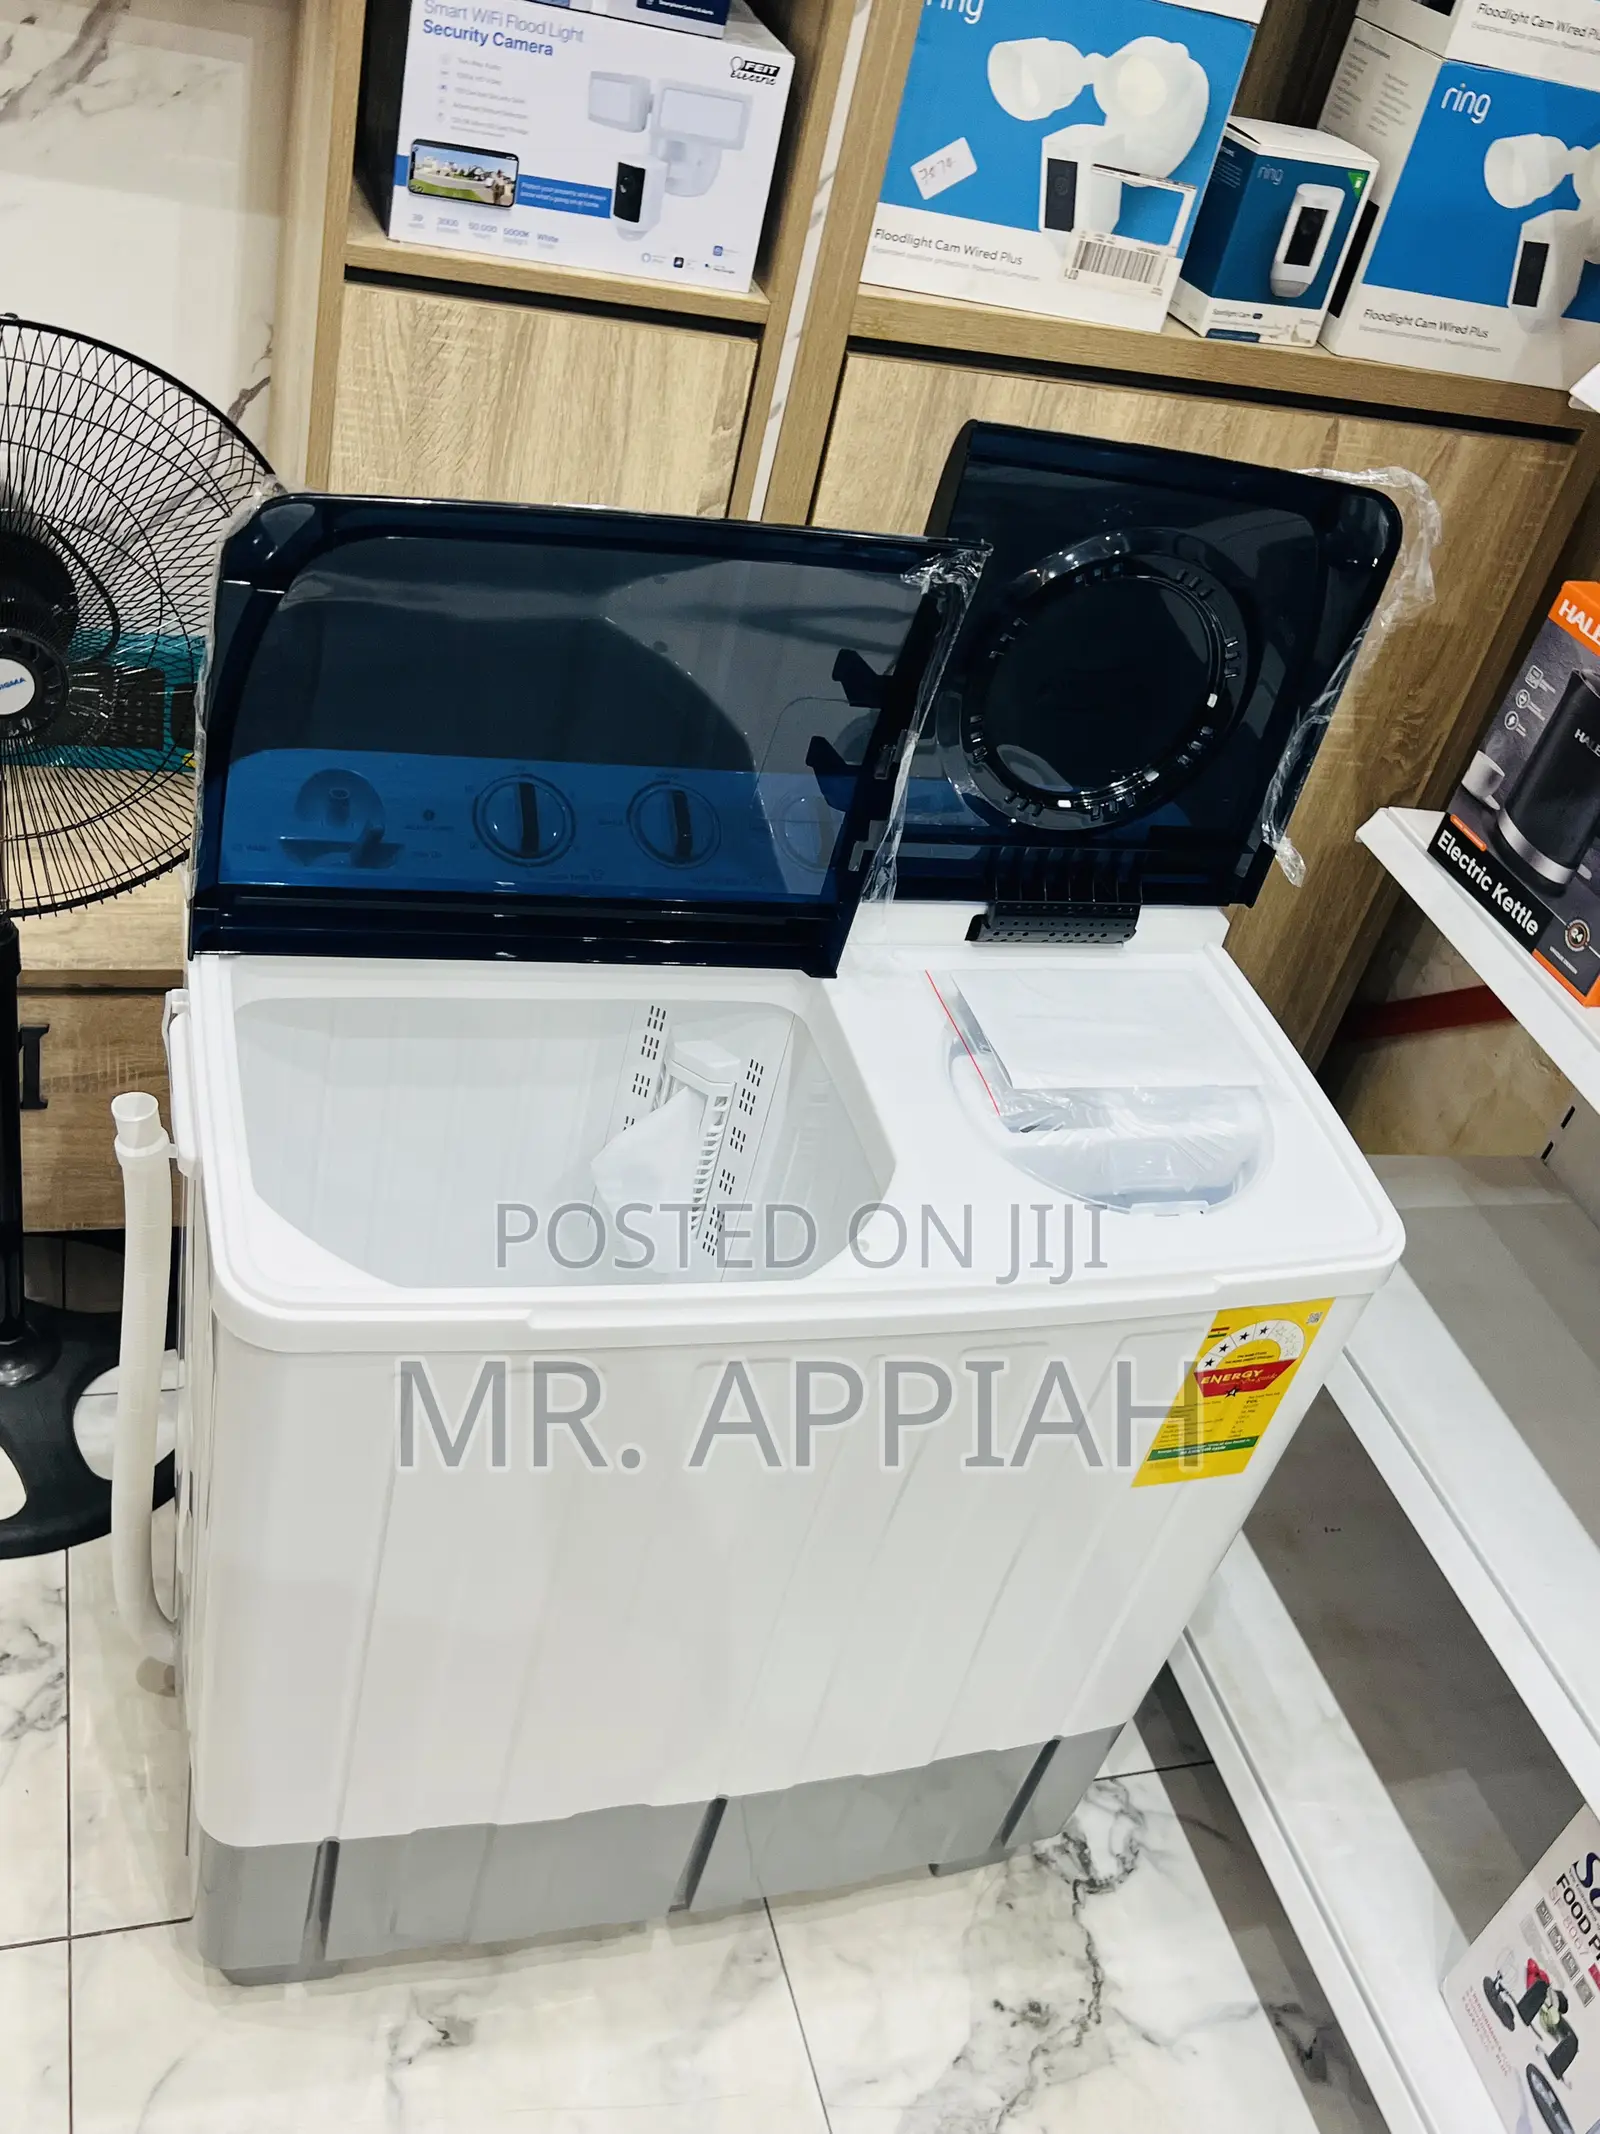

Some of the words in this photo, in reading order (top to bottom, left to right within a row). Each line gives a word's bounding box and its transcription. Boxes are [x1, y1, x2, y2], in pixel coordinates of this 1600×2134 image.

[424, 0, 467, 21] Smart
[506, 13, 546, 34] Flood
[549, 22, 584, 43] Light
[926, 0, 984, 24] ng
[1477, 2, 1530, 24] Floodlight
[1531, 15, 1554, 29] Cam
[423, 19, 488, 47] Security
[493, 32, 553, 56] Camera
[743, 61, 779, 76] FEIT
[1441, 82, 1491, 124] ring
[1257, 163, 1284, 185] ring
[874, 228, 932, 249] Floodlight
[935, 239, 961, 253] Cam
[964, 244, 997, 261] Wired
[1000, 251, 1023, 266] Plus
[1363, 308, 1413, 326] Floodlight
[1415, 317, 1437, 330] Cam
[1439, 320, 1468, 335] Wired
[1469, 326, 1489, 339] Plus
[1437, 829, 1492, 891] Electric
[1491, 882, 1538, 936] Kettle
[1201, 1369, 1264, 1385] ENERGY
[1556, 1873, 1591, 1935] FOOD
